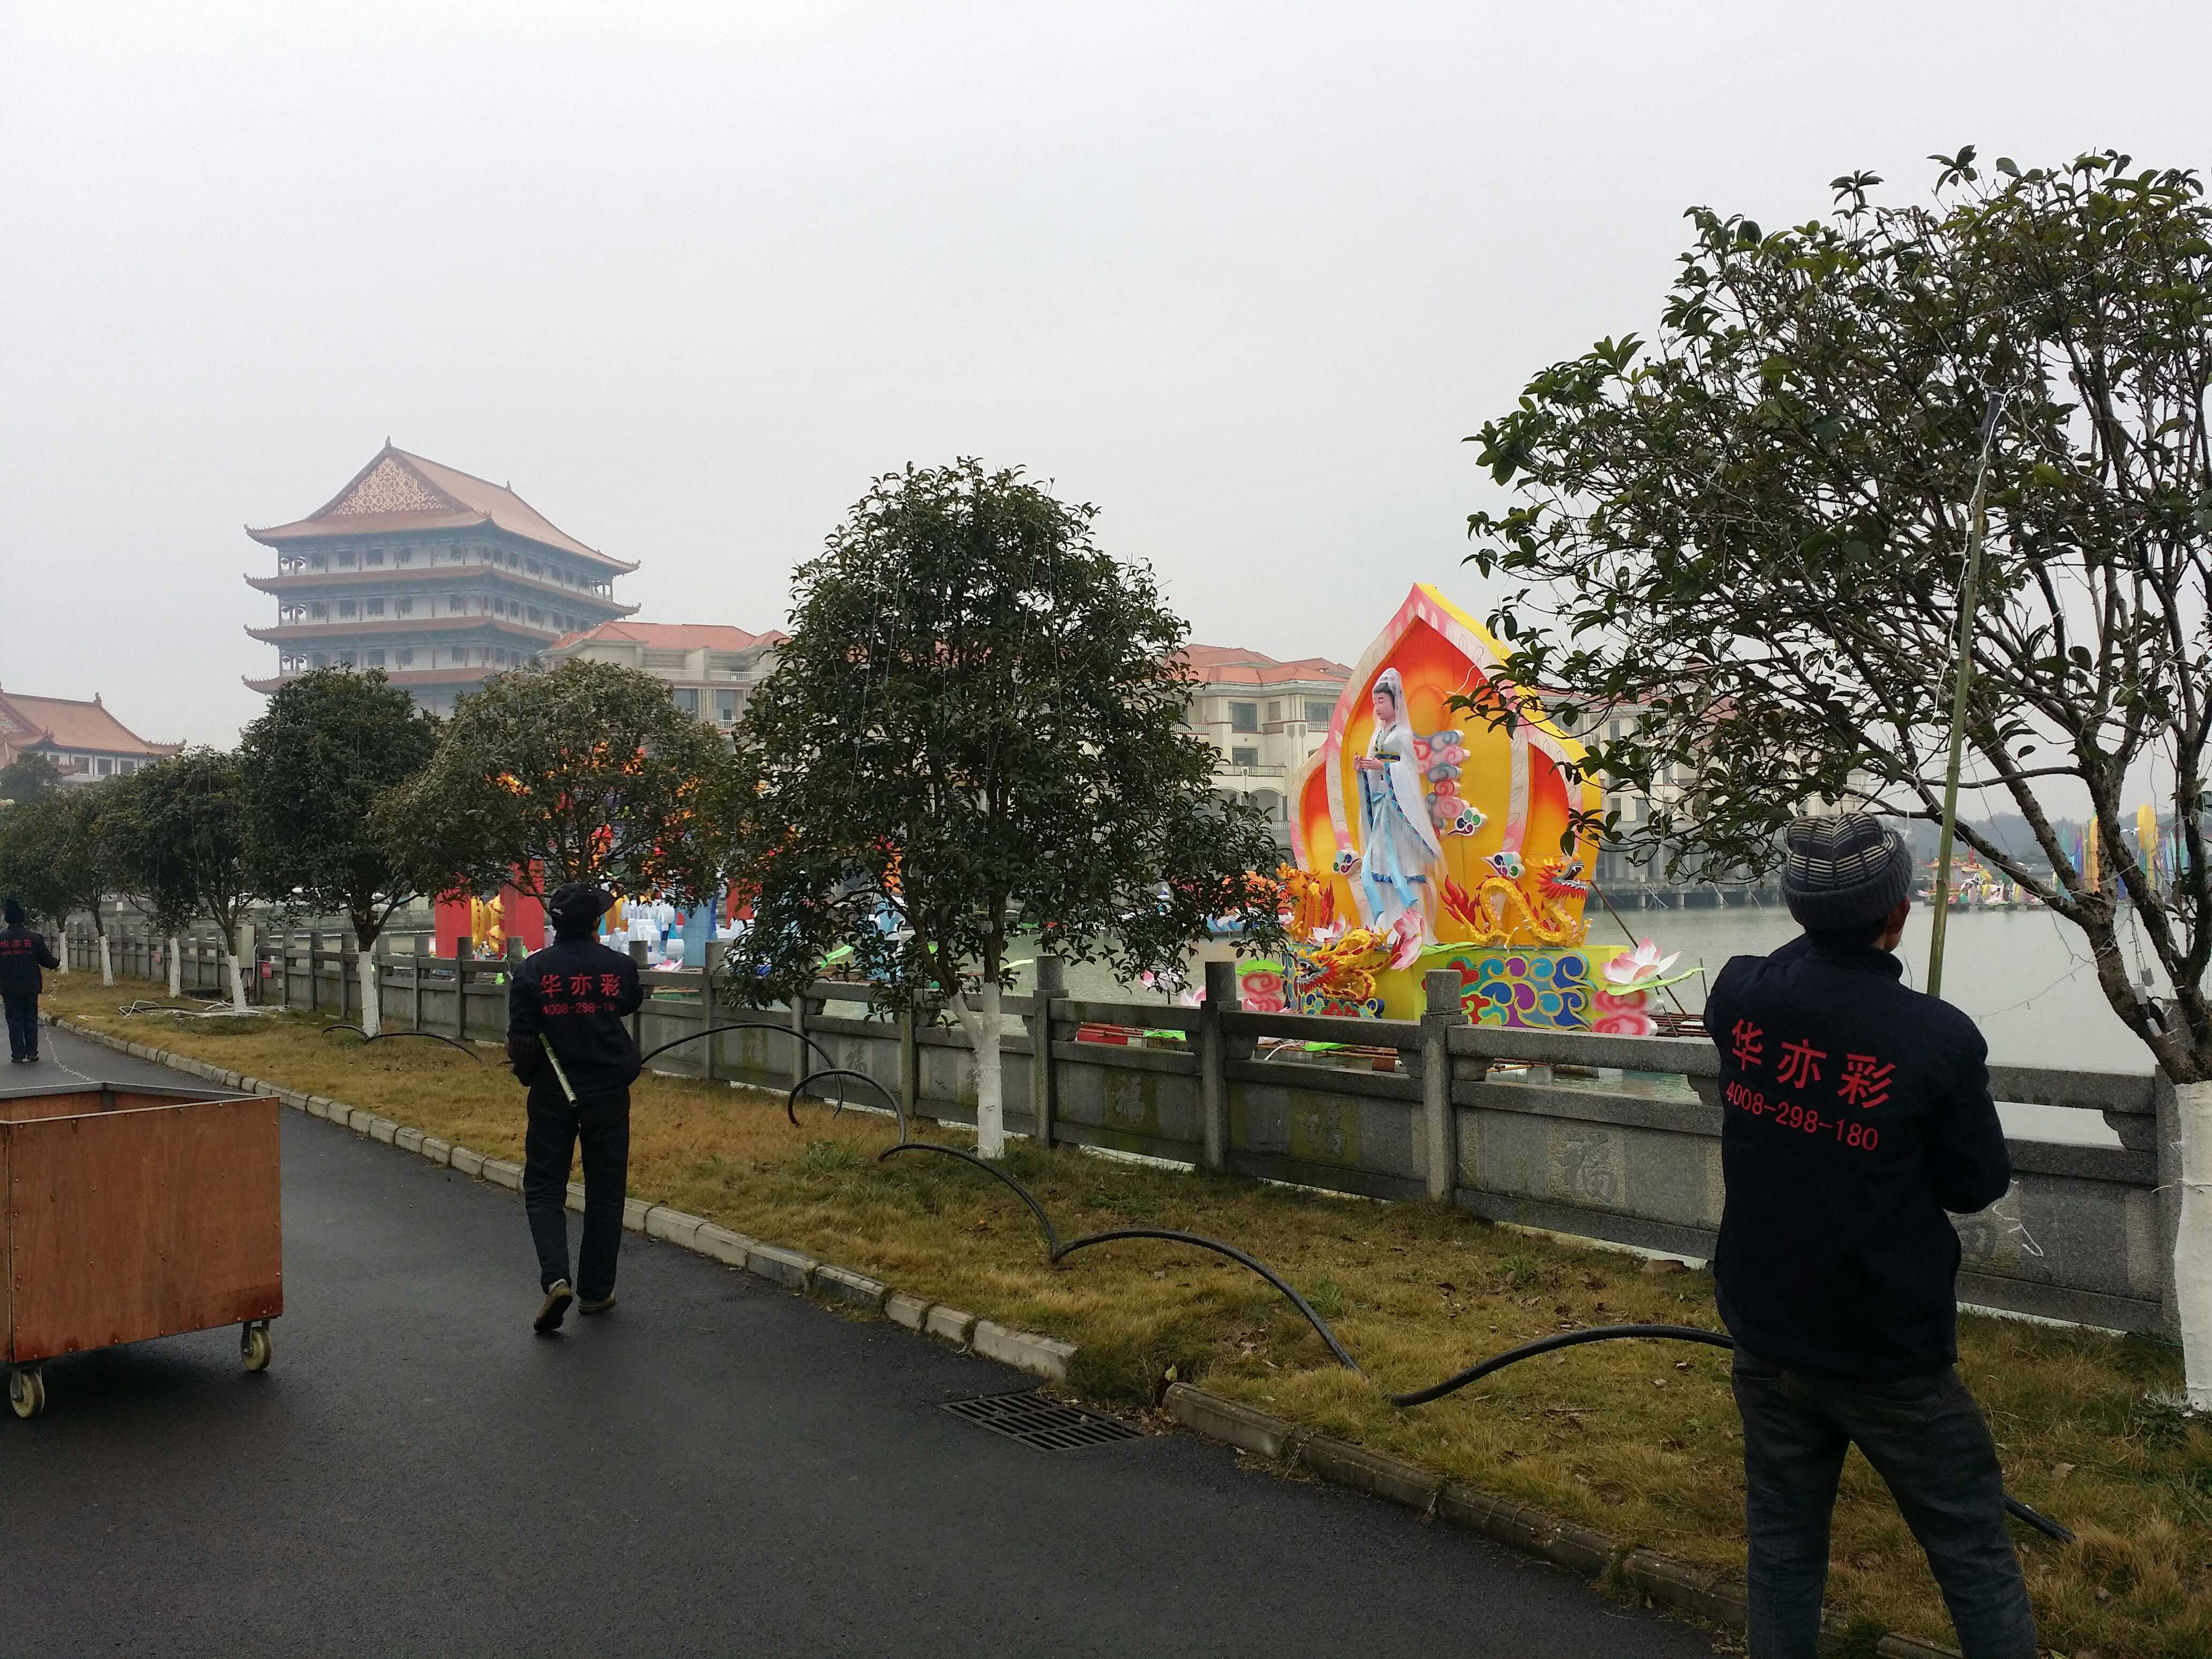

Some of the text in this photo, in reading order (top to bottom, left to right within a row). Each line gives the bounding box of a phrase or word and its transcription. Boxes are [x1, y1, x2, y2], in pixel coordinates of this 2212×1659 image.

[540, 973, 620, 997] 华亦彩
[1731, 1019, 1895, 1108] 华亦彩
[1726, 1081, 1878, 1150] 4008-298-180
